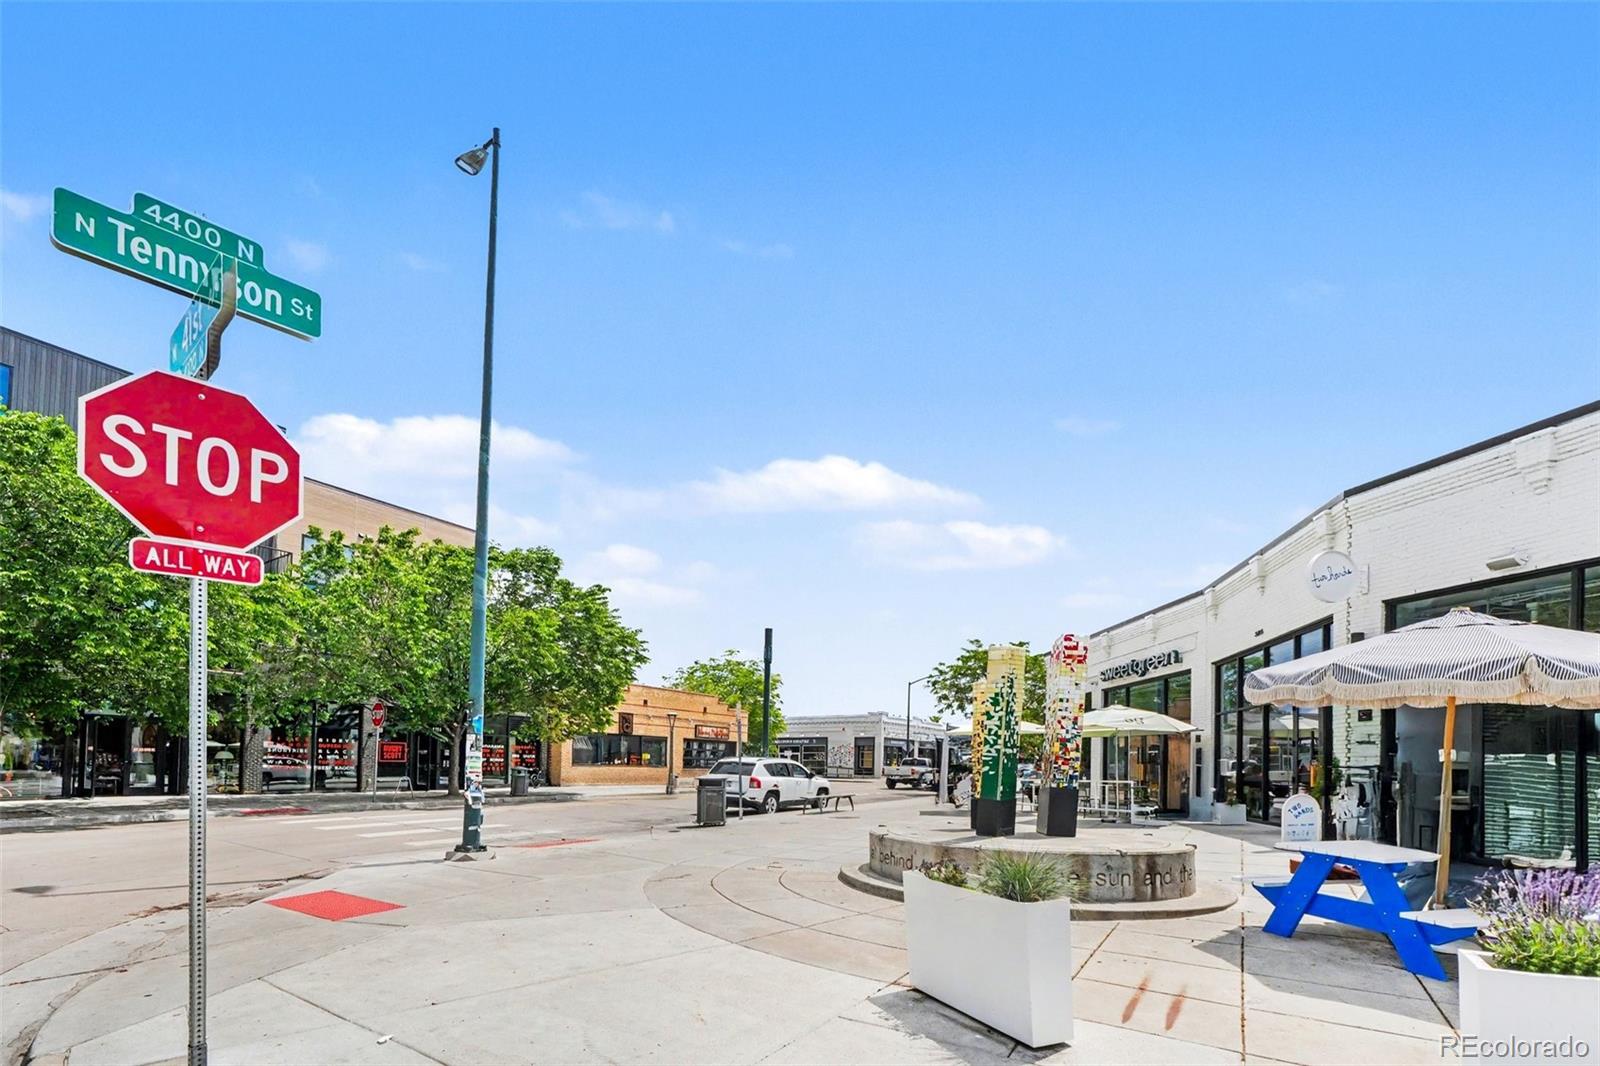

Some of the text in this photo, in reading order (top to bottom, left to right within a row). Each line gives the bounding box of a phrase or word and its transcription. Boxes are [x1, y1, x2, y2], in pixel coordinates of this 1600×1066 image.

[144, 203, 254, 262] 4400 N
[75, 212, 95, 238] N
[290, 297, 314, 320] St
[99, 414, 289, 504] STOP
[145, 546, 251, 578] ALL WAY
[1099, 650, 1183, 681] sweetgreen
[1288, 803, 1302, 814] TWO
[1294, 807, 1315, 819] HANDS
[879, 850, 914, 870] behind
[1095, 871, 1131, 887] sun
[1143, 866, 1172, 886] and
